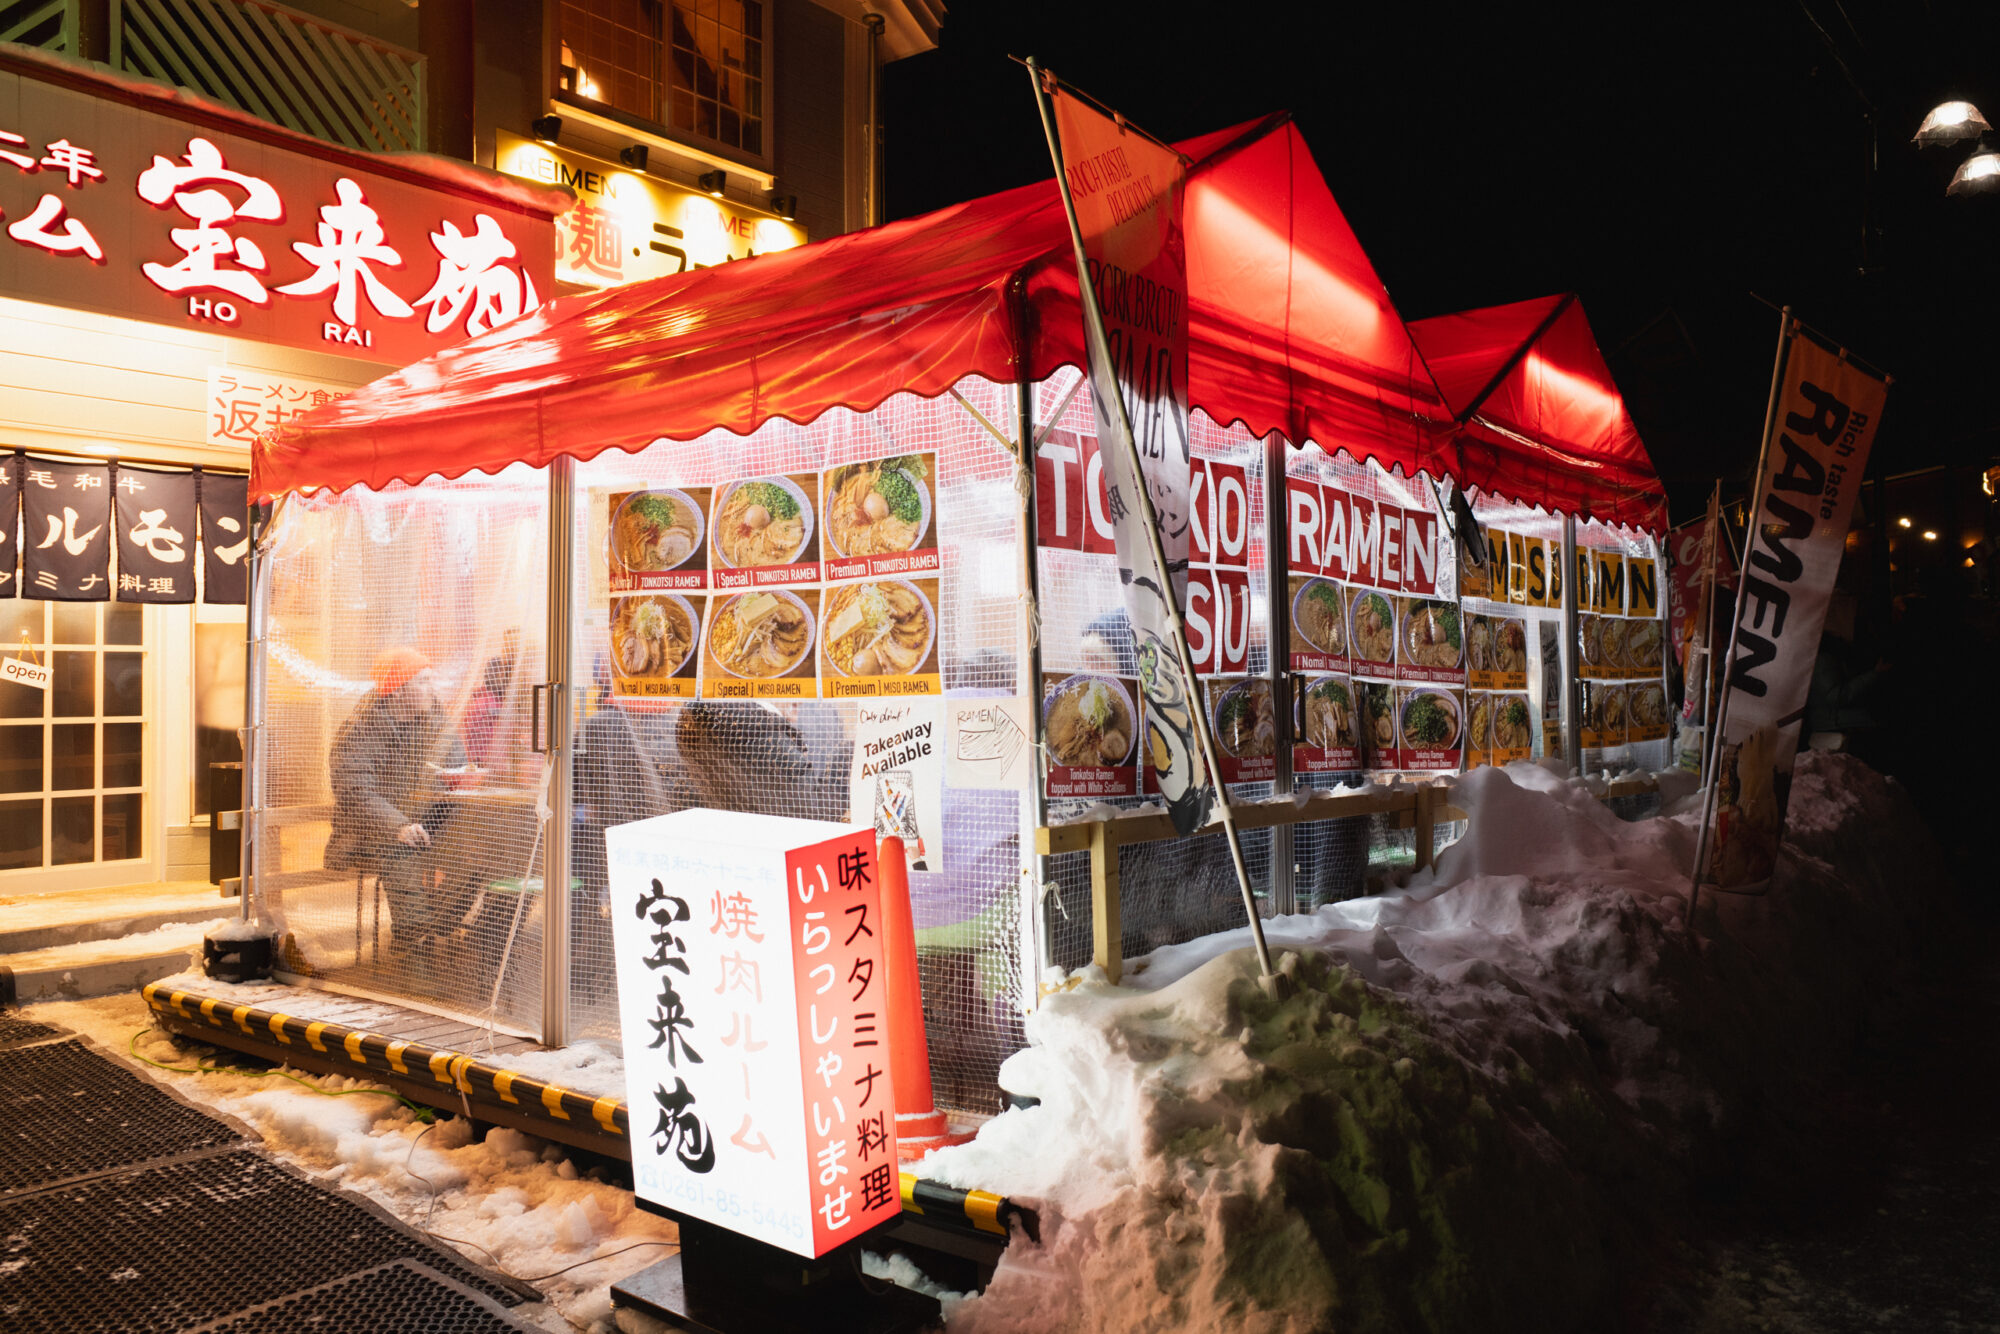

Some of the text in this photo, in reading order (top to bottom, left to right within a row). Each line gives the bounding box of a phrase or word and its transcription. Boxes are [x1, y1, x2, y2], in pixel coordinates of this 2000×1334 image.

[1065, 158, 1104, 202] RICH
[138, 137, 540, 338] 宝来苑
[189, 299, 237, 322] HO
[1087, 257, 1132, 326] PORK
[323, 322, 372, 348] RAI
[1819, 410, 1869, 520] Rich taste
[0, 506, 248, 565] ルモン
[1290, 489, 1436, 583] RAMEN
[1729, 380, 1850, 698] RAMEN
[641, 576, 674, 588] TONKOTSU
[674, 575, 701, 588] RAMEN
[756, 570, 789, 583] TONKOTSU
[790, 567, 817, 580] RAMEN
[872, 558, 908, 573] TONKOTSU
[909, 554, 938, 569] RAMEN
[1488, 538, 1562, 600] MISO
[6, 664, 47, 682] open
[757, 683, 775, 694] MISO
[776, 683, 801, 694] RAMEN
[883, 681, 901, 694] MISO
[903, 680, 929, 693] RAMEN
[956, 707, 995, 726] RAMEN
[861, 741, 932, 780] Available
[863, 721, 932, 758] Takeaway
[635, 877, 716, 1174] 宝来苑
[709, 889, 777, 1161] 焼肉ルーム
[796, 863, 852, 1231] いらっしゃいませ
[837, 846, 893, 1212] 味スタミナ料理
